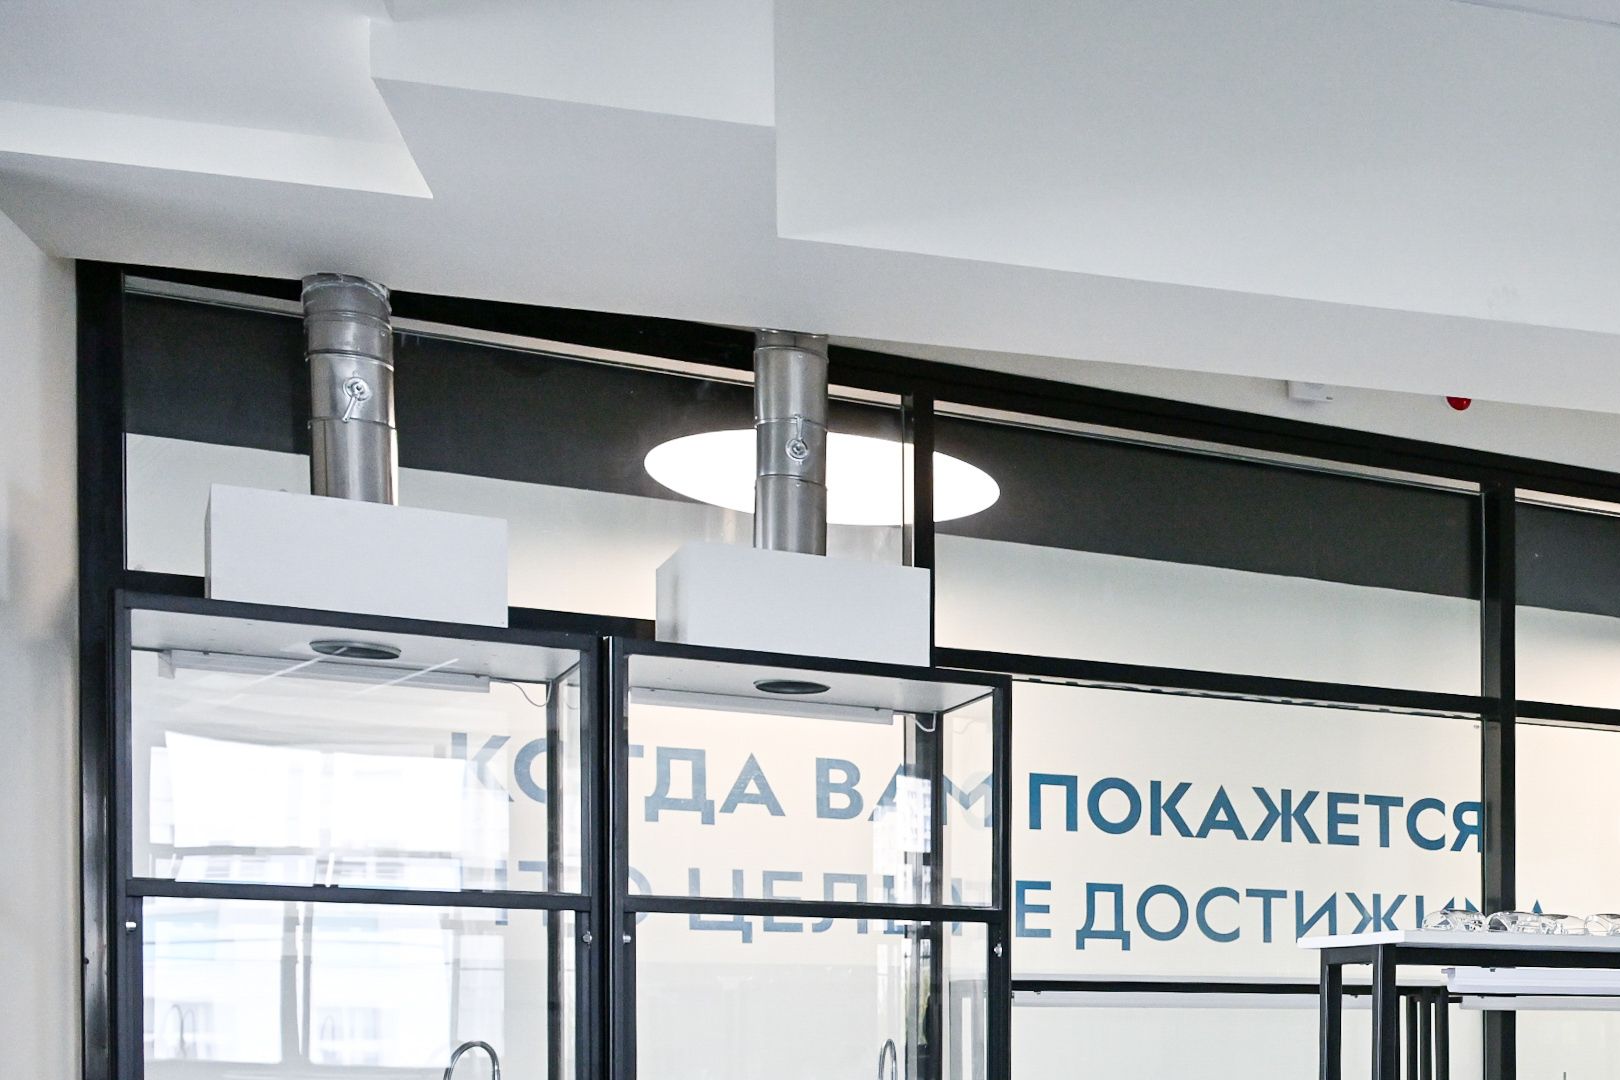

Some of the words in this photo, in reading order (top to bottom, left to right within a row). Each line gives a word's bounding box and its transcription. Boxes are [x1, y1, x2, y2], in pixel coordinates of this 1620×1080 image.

[451, 731, 786, 825] КОДА
[1028, 771, 1485, 854] ПОКАЖЕТСЯ
[1075, 880, 1543, 952] ДОСТИЖИ
